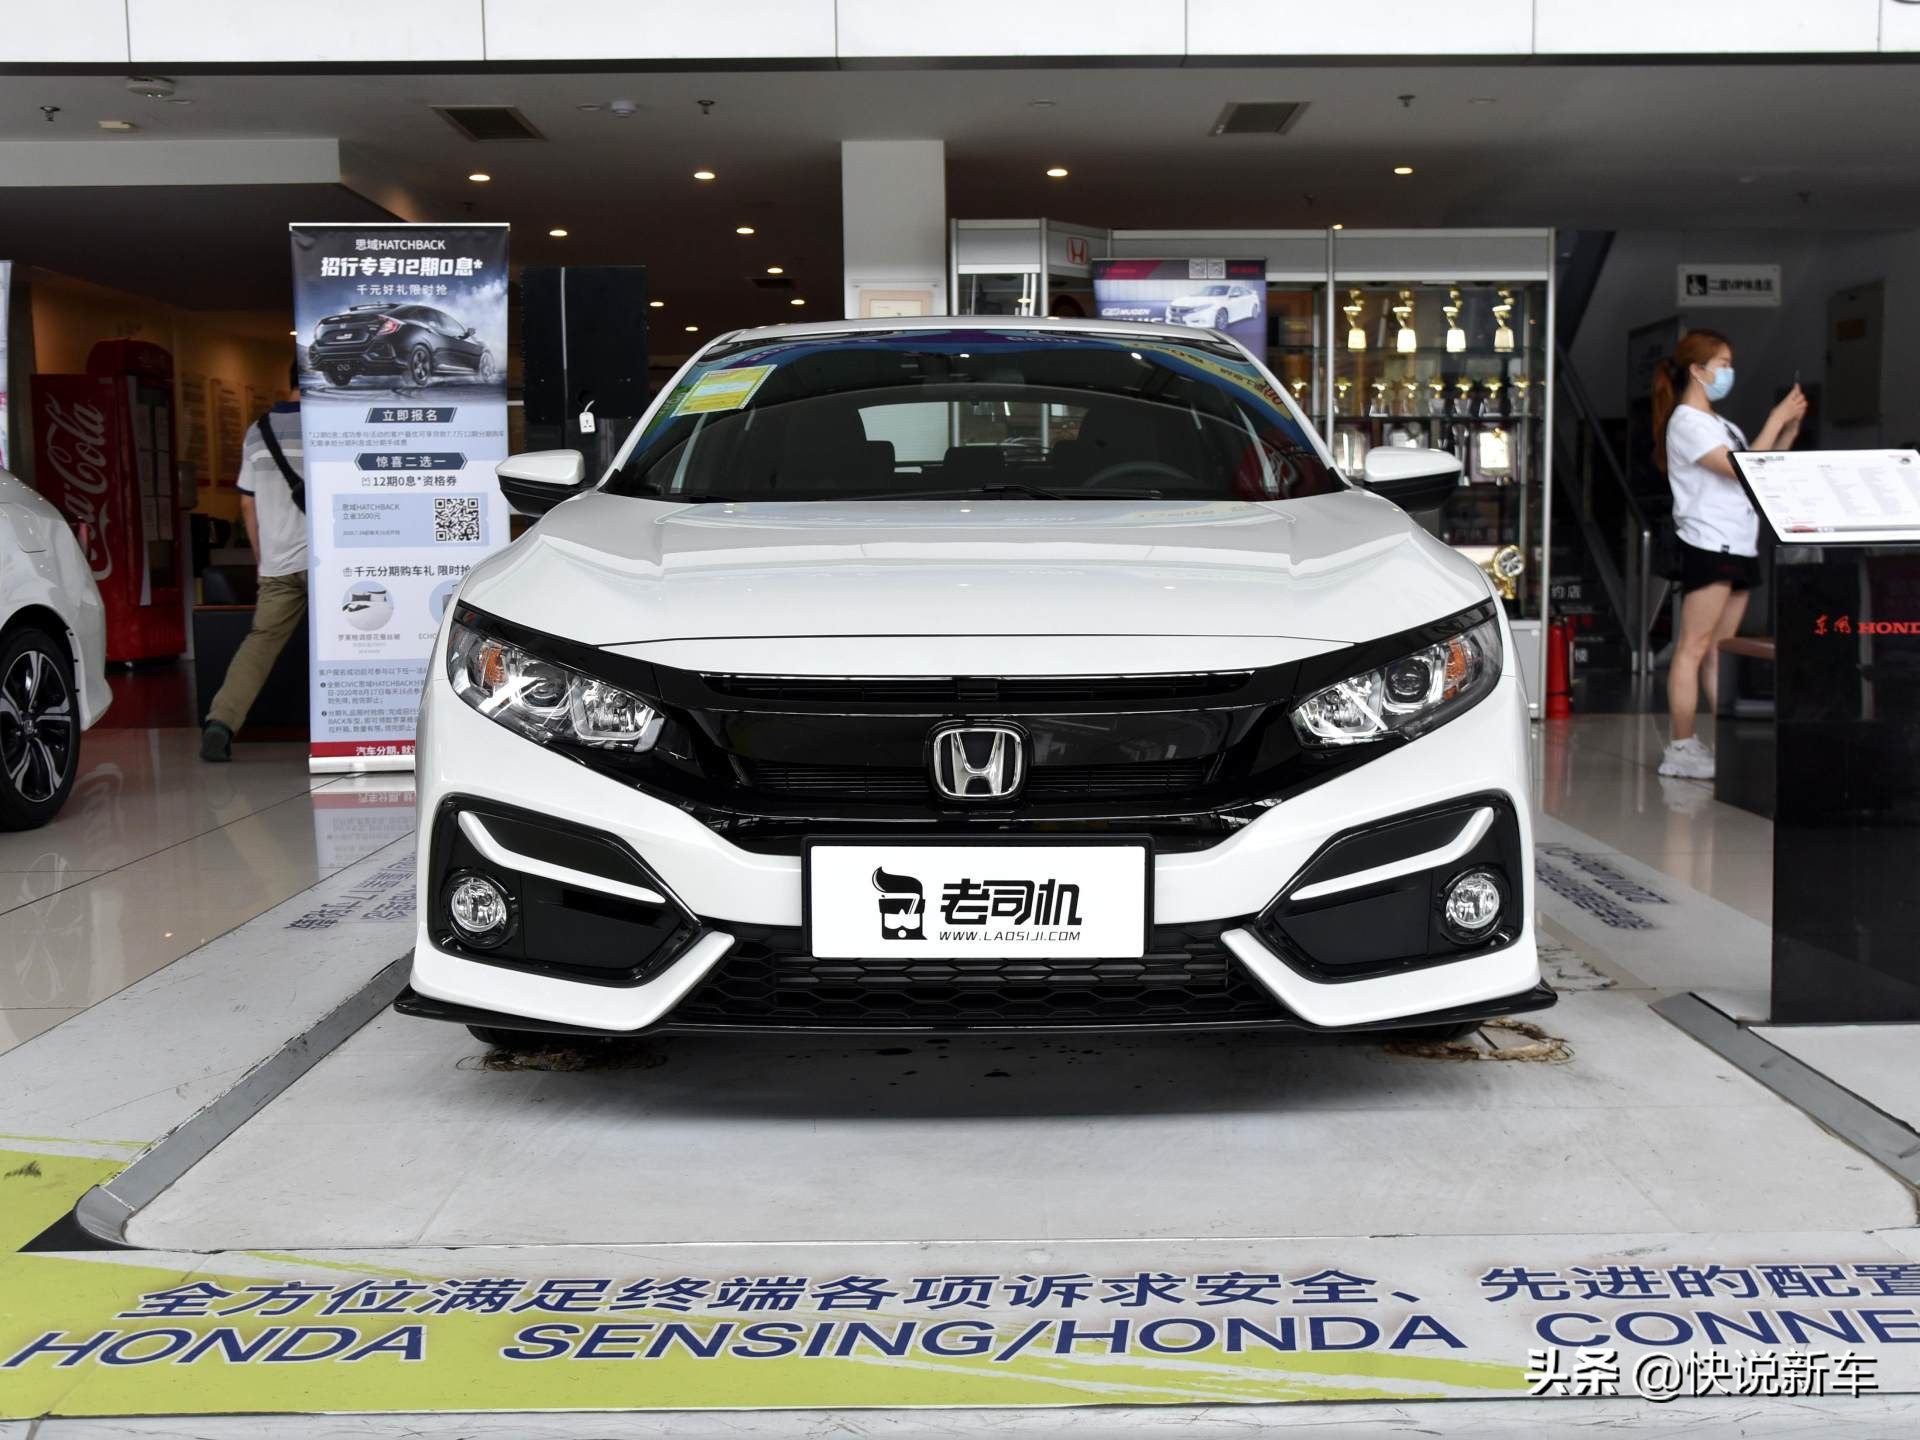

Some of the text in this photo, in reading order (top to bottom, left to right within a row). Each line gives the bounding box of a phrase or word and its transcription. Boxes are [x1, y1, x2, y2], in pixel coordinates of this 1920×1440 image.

[355, 239, 446, 251] 思域HATCHBACK
[357, 284, 448, 296] 千元好礼限时抢
[382, 409, 438, 422] 立即报名
[376, 455, 447, 468] 惊喜二选一
[354, 565, 435, 577] 千元分期购车礼
[939, 878, 1083, 926] 老司机
[939, 931, 1081, 942] WWW.LAOSIJI.COM
[2, 1311, 1920, 1368] HONDA SENSING/HONDA CONNE
